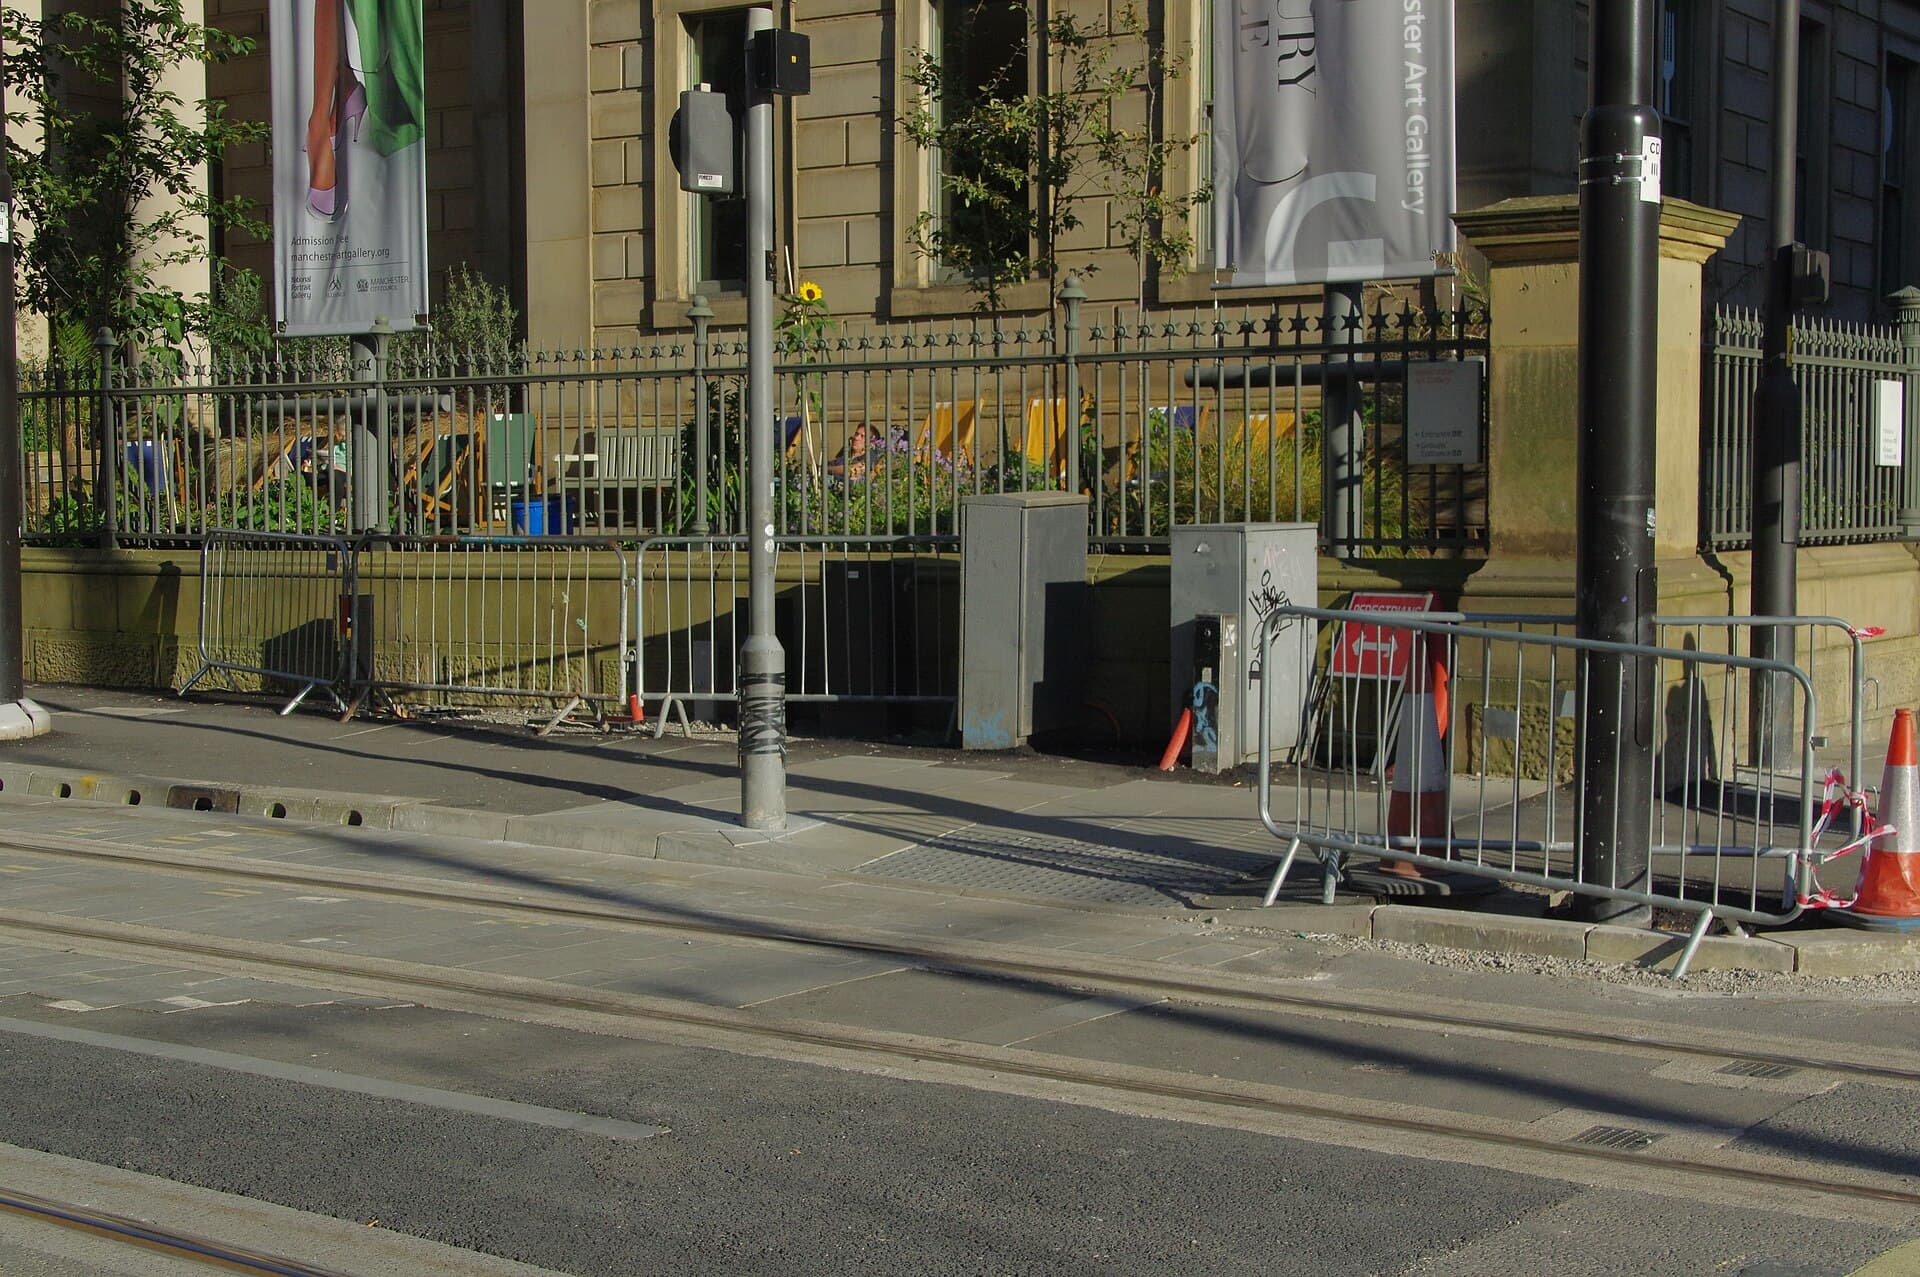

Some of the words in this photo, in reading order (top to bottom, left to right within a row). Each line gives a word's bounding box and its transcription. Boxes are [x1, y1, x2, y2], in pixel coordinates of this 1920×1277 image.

[1404, 61, 1428, 107] Art
[1401, 114, 1431, 215] Gallery
[291, 236, 334, 246] Admission
[291, 247, 390, 262] manchestartgallery.org
[370, 275, 409, 285] MANCHESTER
